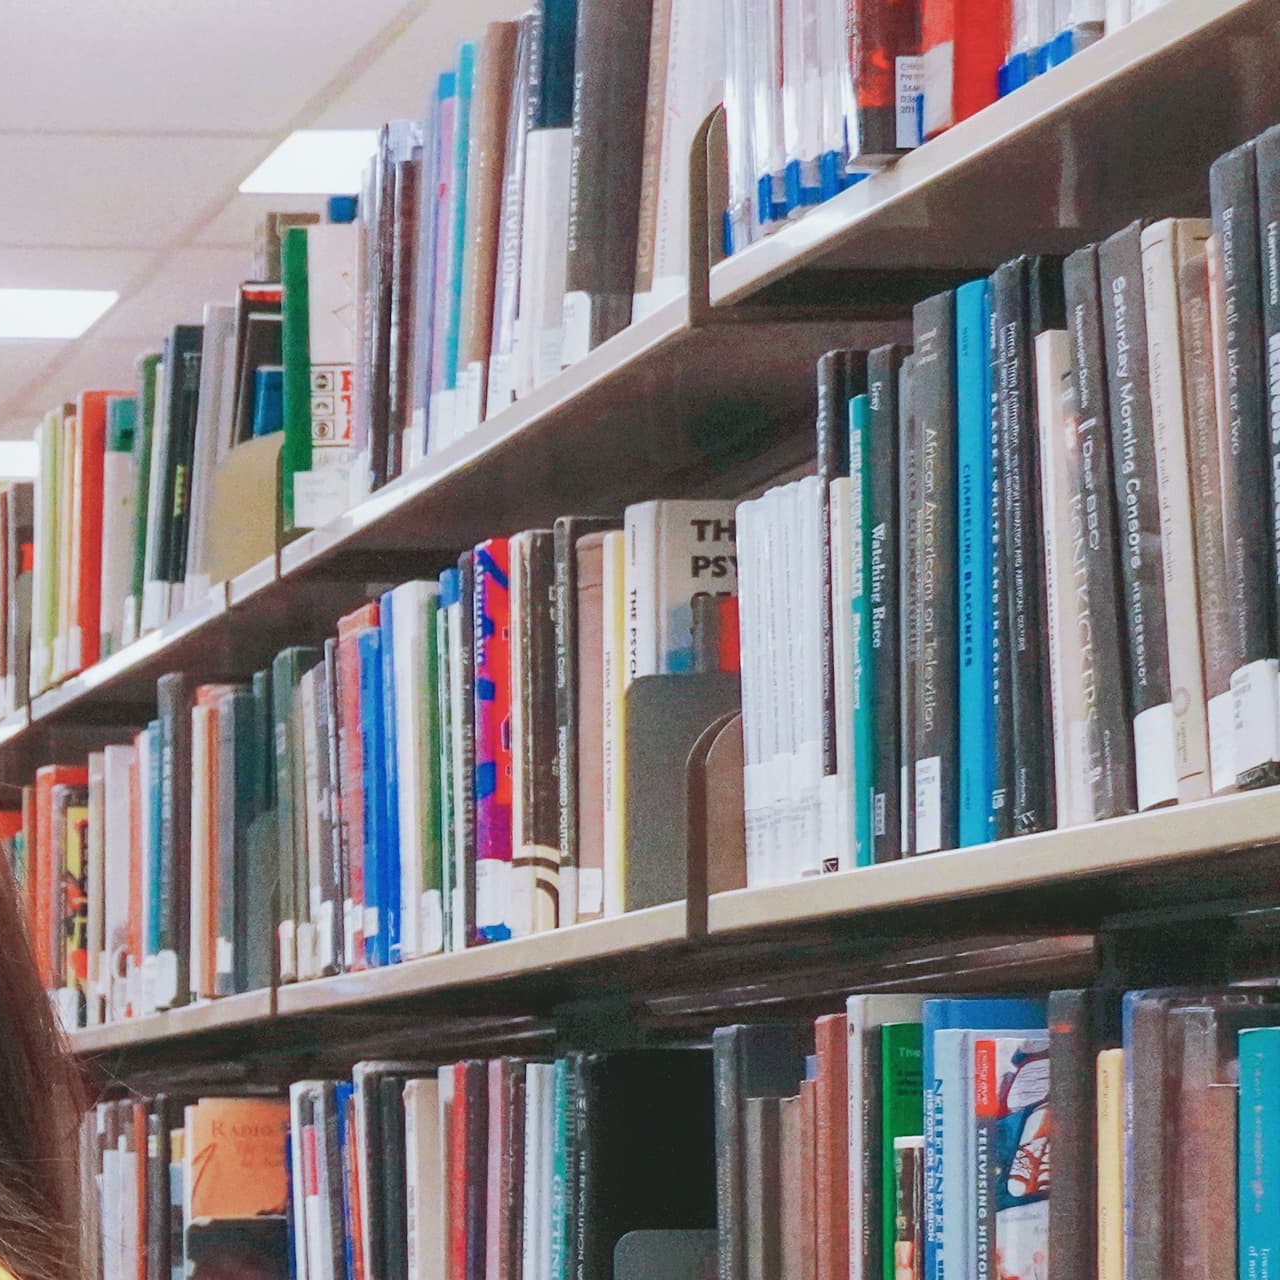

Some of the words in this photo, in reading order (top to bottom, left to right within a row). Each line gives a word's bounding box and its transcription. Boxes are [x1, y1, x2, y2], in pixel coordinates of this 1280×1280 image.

[1222, 207, 1235, 281] Because
[1005, 322, 1017, 357] Prime
[1111, 276, 1130, 378] Saturday
[1007, 360, 1018, 388] Time
[923, 428, 937, 493] African
[1118, 383, 1137, 474] Morning
[924, 501, 937, 601] Americans
[962, 464, 972, 566] CHANNELING
[1125, 478, 1142, 569] Censors
[870, 522, 886, 603] Watching
[871, 605, 886, 649] Race
[923, 608, 934, 633] on
[963, 571, 973, 668] BLACKNESS
[1131, 581, 1147, 687] HENDERSHOT
[923, 638, 939, 733] Television
[925, 1088, 935, 1142] HISTORY
[926, 1147, 935, 1166] ON
[977, 1127, 987, 1219] TELEVISING
[926, 1169, 935, 1242] TELEVISION
[1248, 1245, 1259, 1257] of
